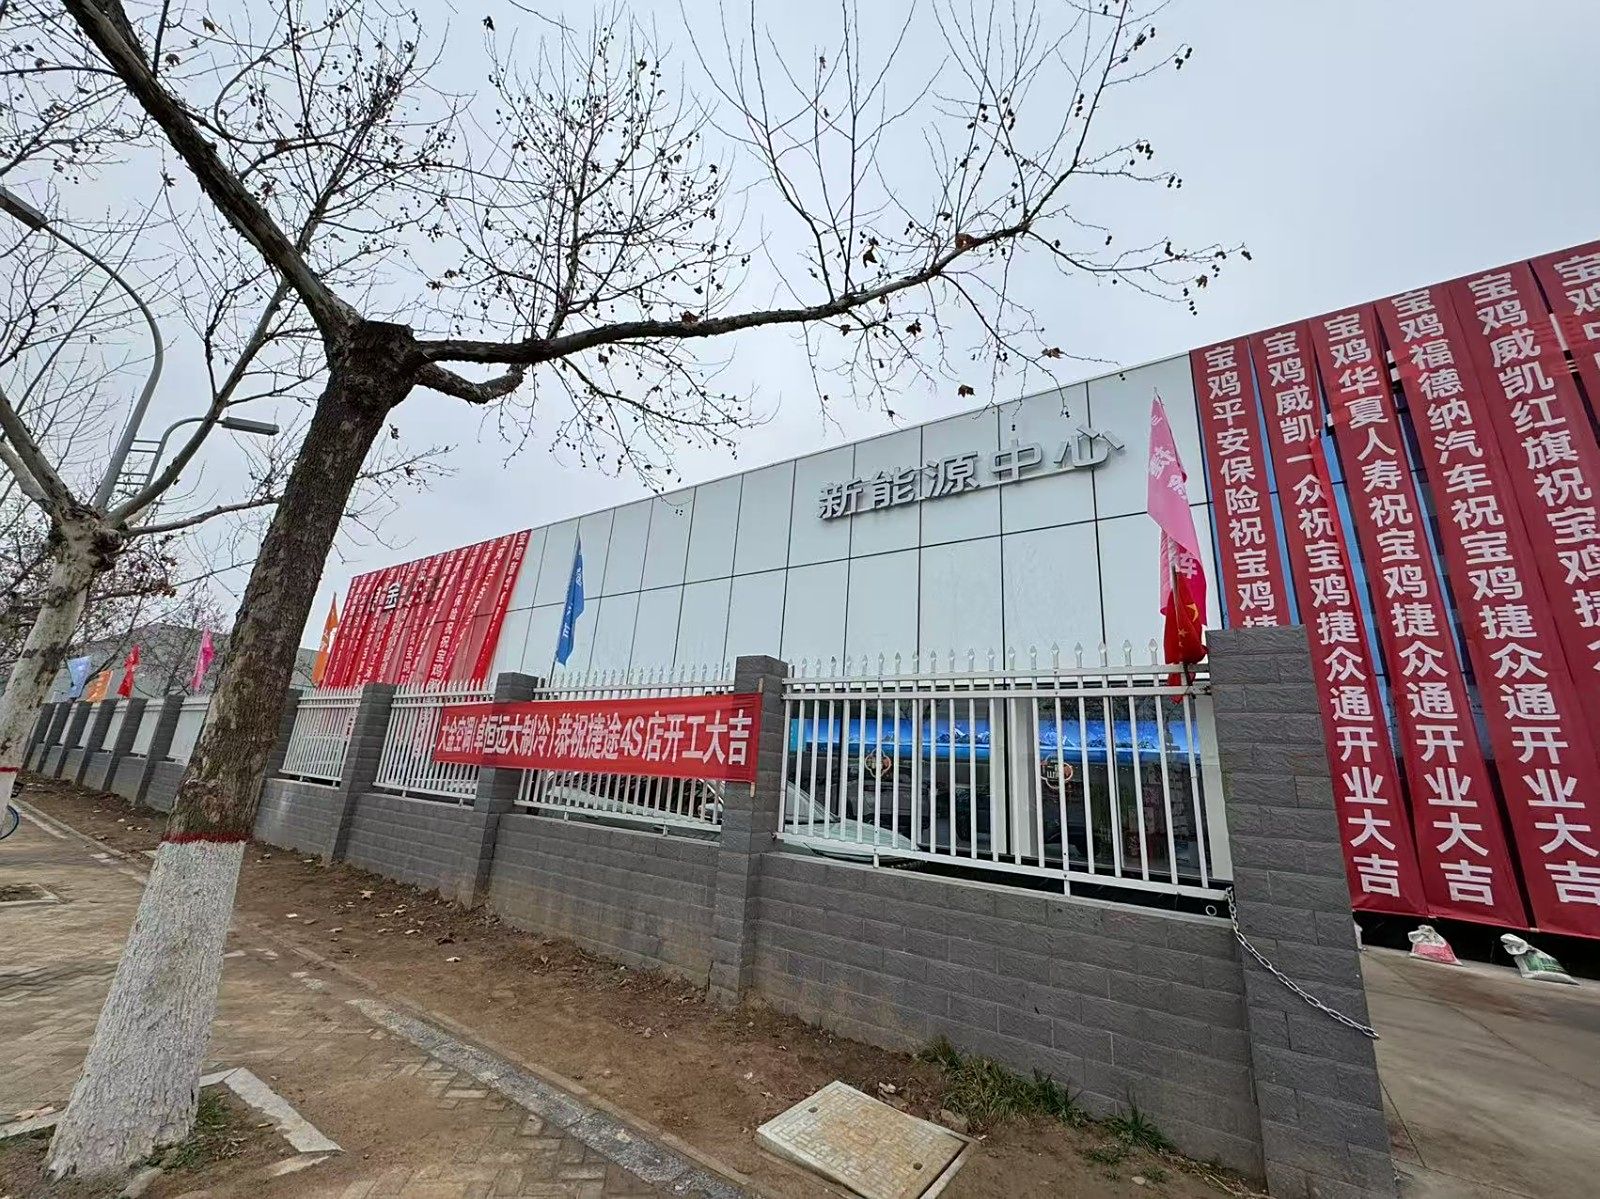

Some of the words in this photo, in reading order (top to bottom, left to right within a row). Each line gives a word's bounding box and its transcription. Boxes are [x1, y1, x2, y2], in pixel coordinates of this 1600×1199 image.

[817, 424, 1125, 519] 新能源中心
[1468, 271, 1600, 670] 宝鸡威凯红旗祝宝鸡
[1553, 255, 1600, 371] 宝鸡
[1262, 330, 1400, 897] 宝鸡威凯一众祝宝鸡捷众通开业大吉
[1323, 313, 1494, 906] 宝鸡华夏人寿祝宝鸡捷众通开业大吉
[1391, 289, 1600, 908] 宝鸡福德纳汽车祝宝鸡捷众通开业大吉
